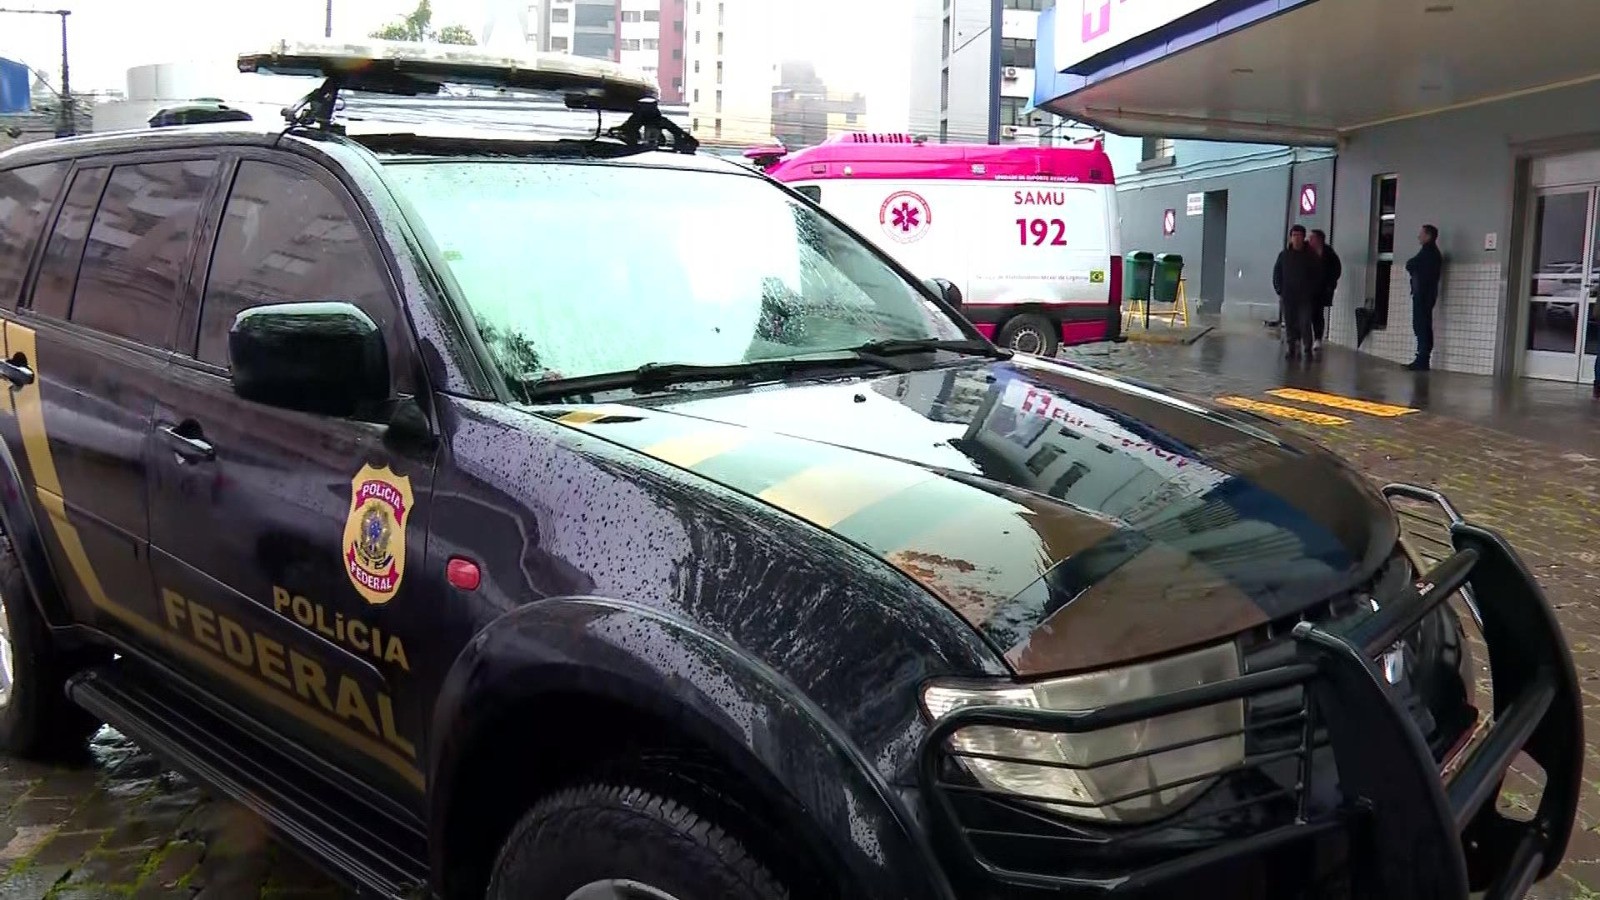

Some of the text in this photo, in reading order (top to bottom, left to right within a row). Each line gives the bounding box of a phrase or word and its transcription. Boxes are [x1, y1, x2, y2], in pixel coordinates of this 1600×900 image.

[1014, 190, 1065, 206] SAMU
[1016, 218, 1067, 246] 192
[351, 561, 392, 590] FEDERAL
[162, 587, 416, 759] FEDERAL
